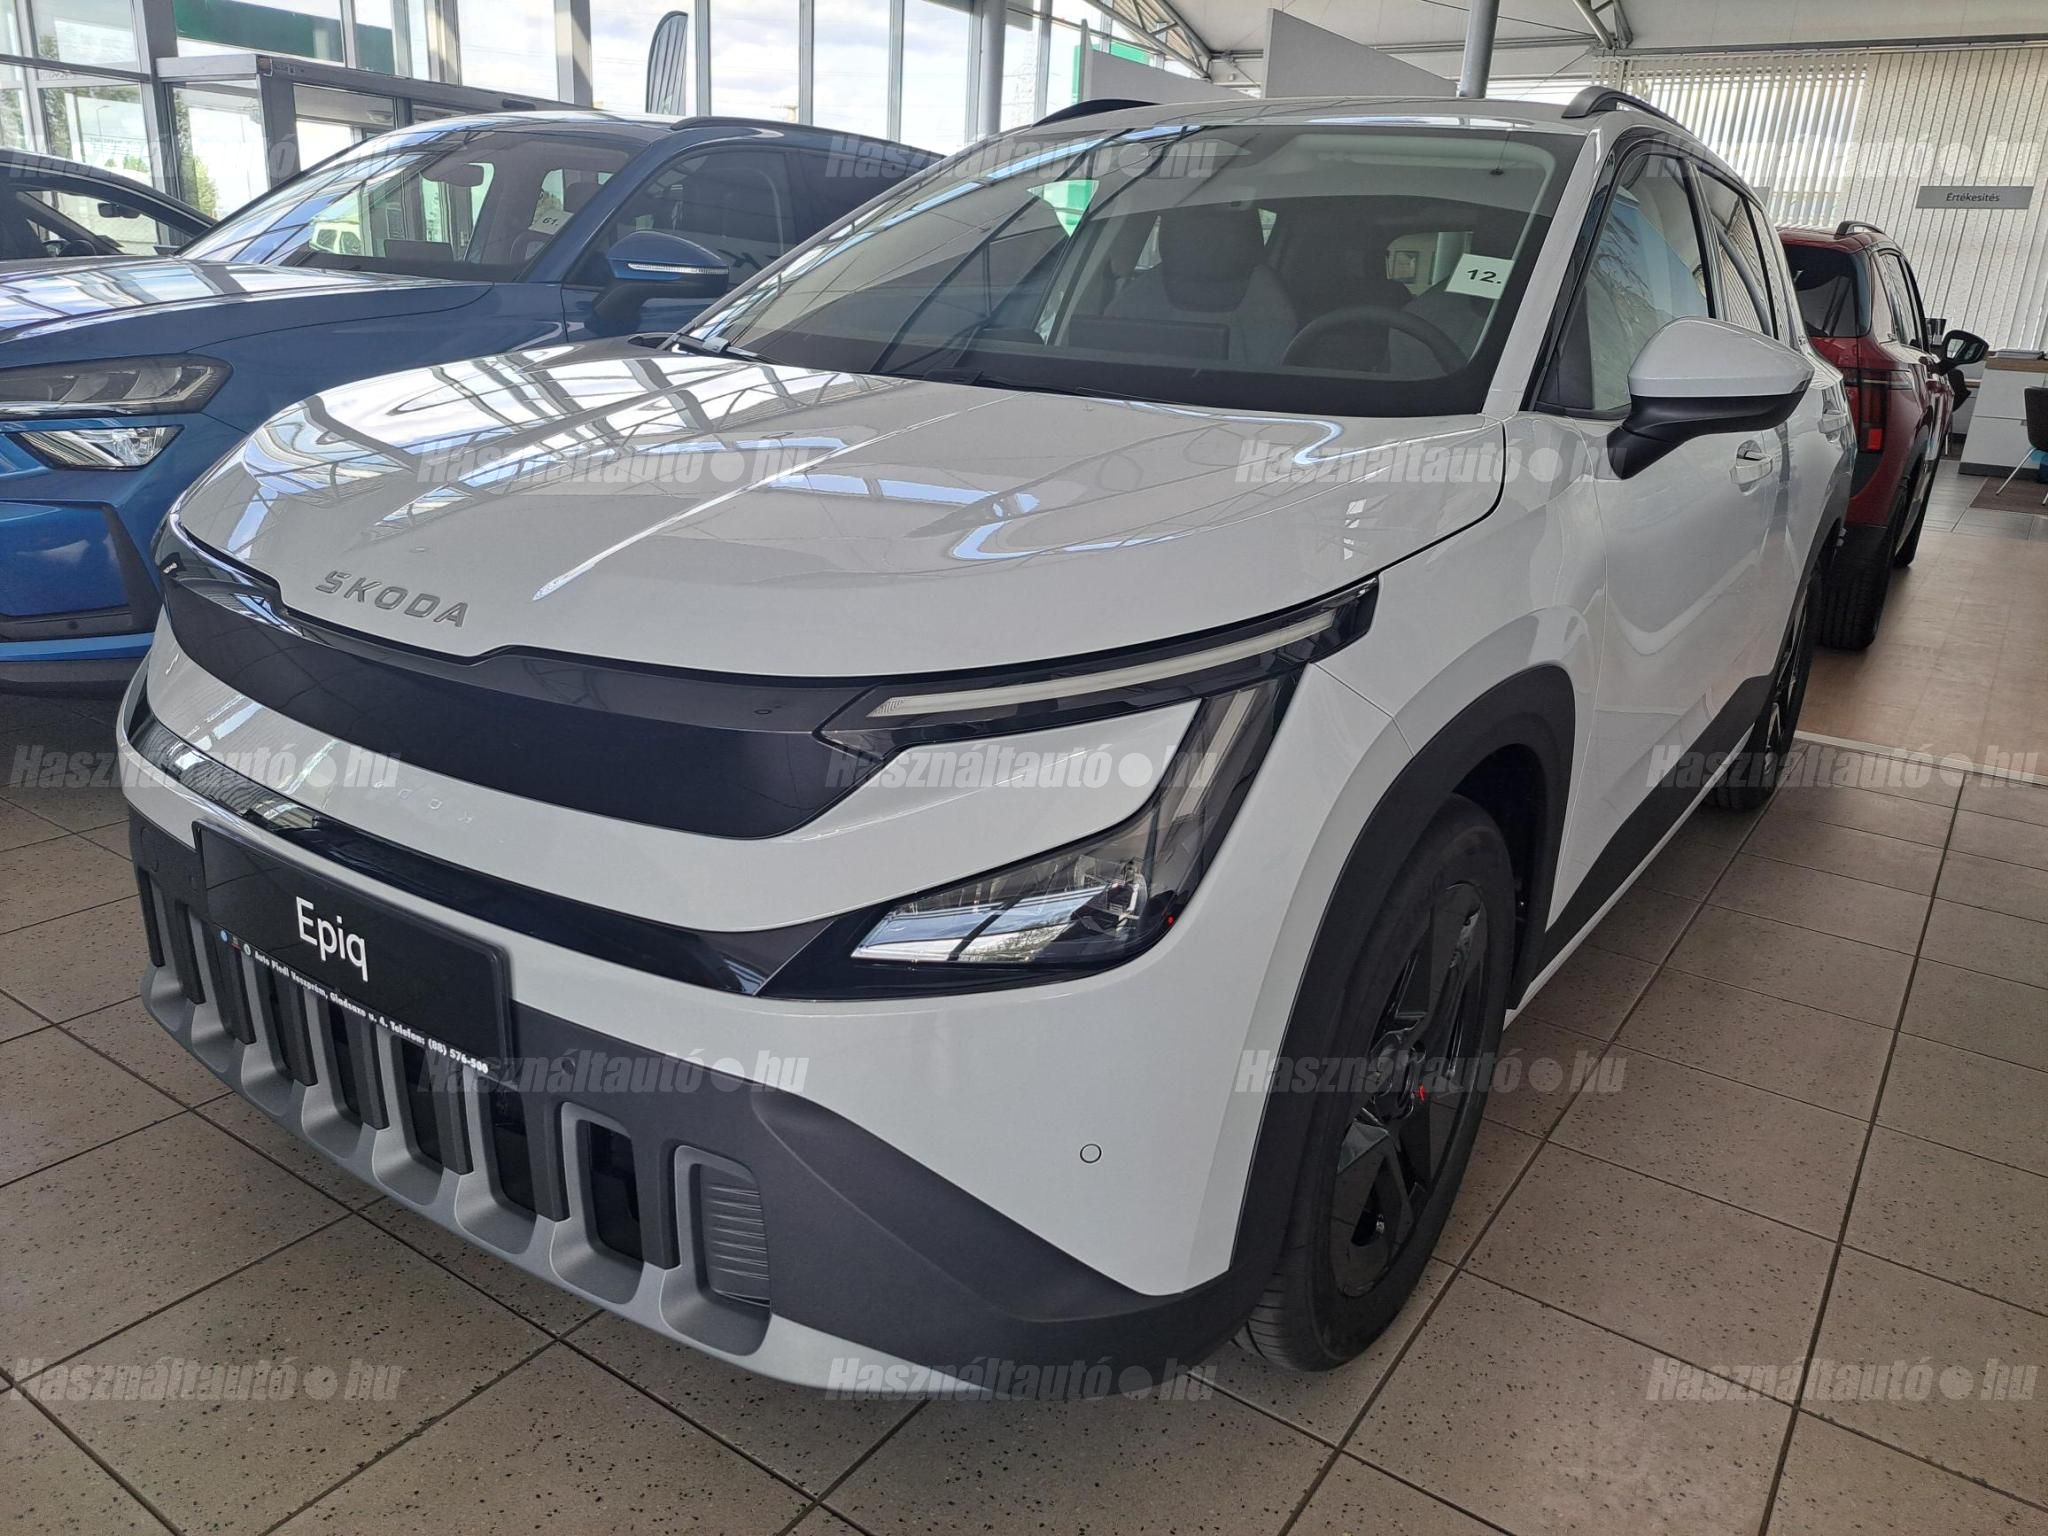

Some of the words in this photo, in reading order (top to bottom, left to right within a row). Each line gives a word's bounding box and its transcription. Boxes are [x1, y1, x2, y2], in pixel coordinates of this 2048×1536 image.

[1467, 268, 1502, 284] 12.
[296, 896, 369, 982] Epiq
[390, 1020, 425, 1045] Telefon:
[428, 1038, 447, 1056] (88)
[450, 1048, 489, 1074] 576-500
